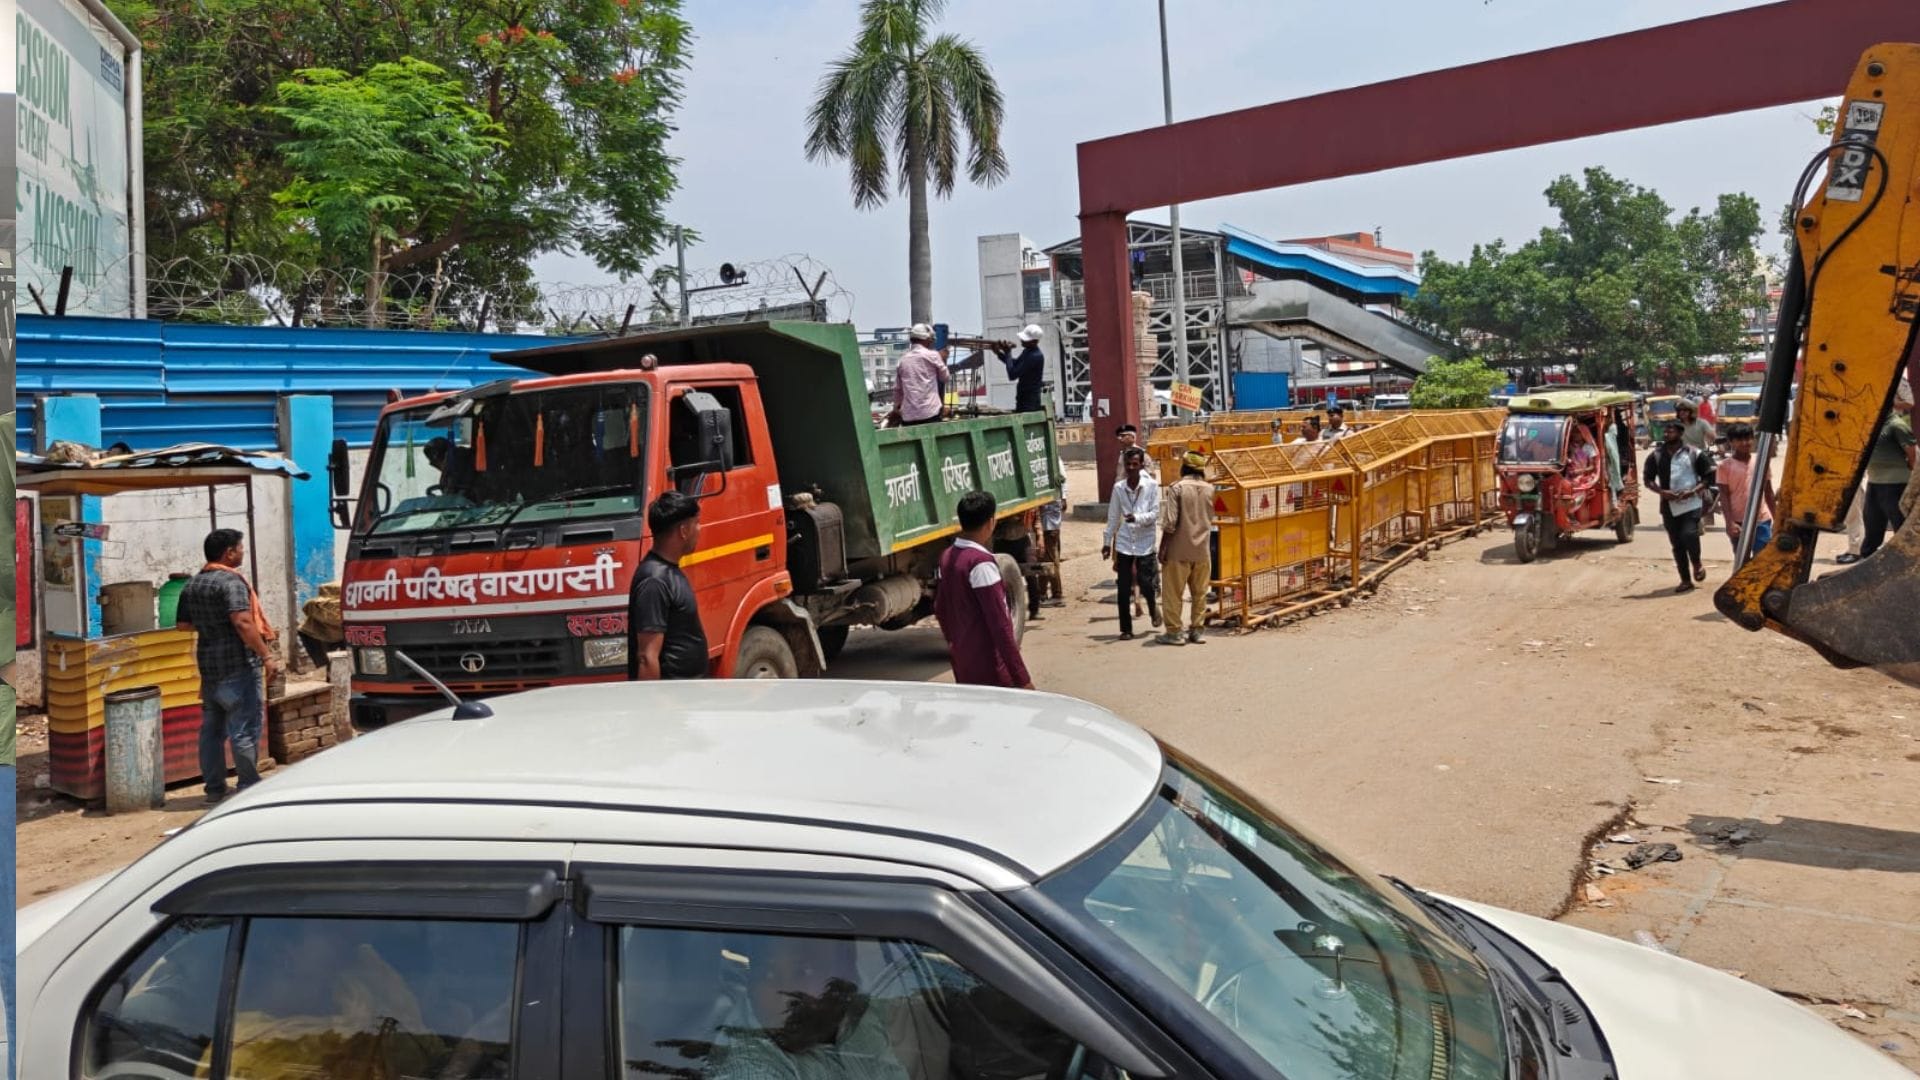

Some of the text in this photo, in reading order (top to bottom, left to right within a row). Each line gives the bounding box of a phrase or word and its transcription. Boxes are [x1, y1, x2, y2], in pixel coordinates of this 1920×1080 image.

[18, 101, 49, 166] EVERY
[33, 185, 99, 288] MISSION
[480, 553, 623, 597] वाराणसी
[451, 620, 492, 634] TATA
